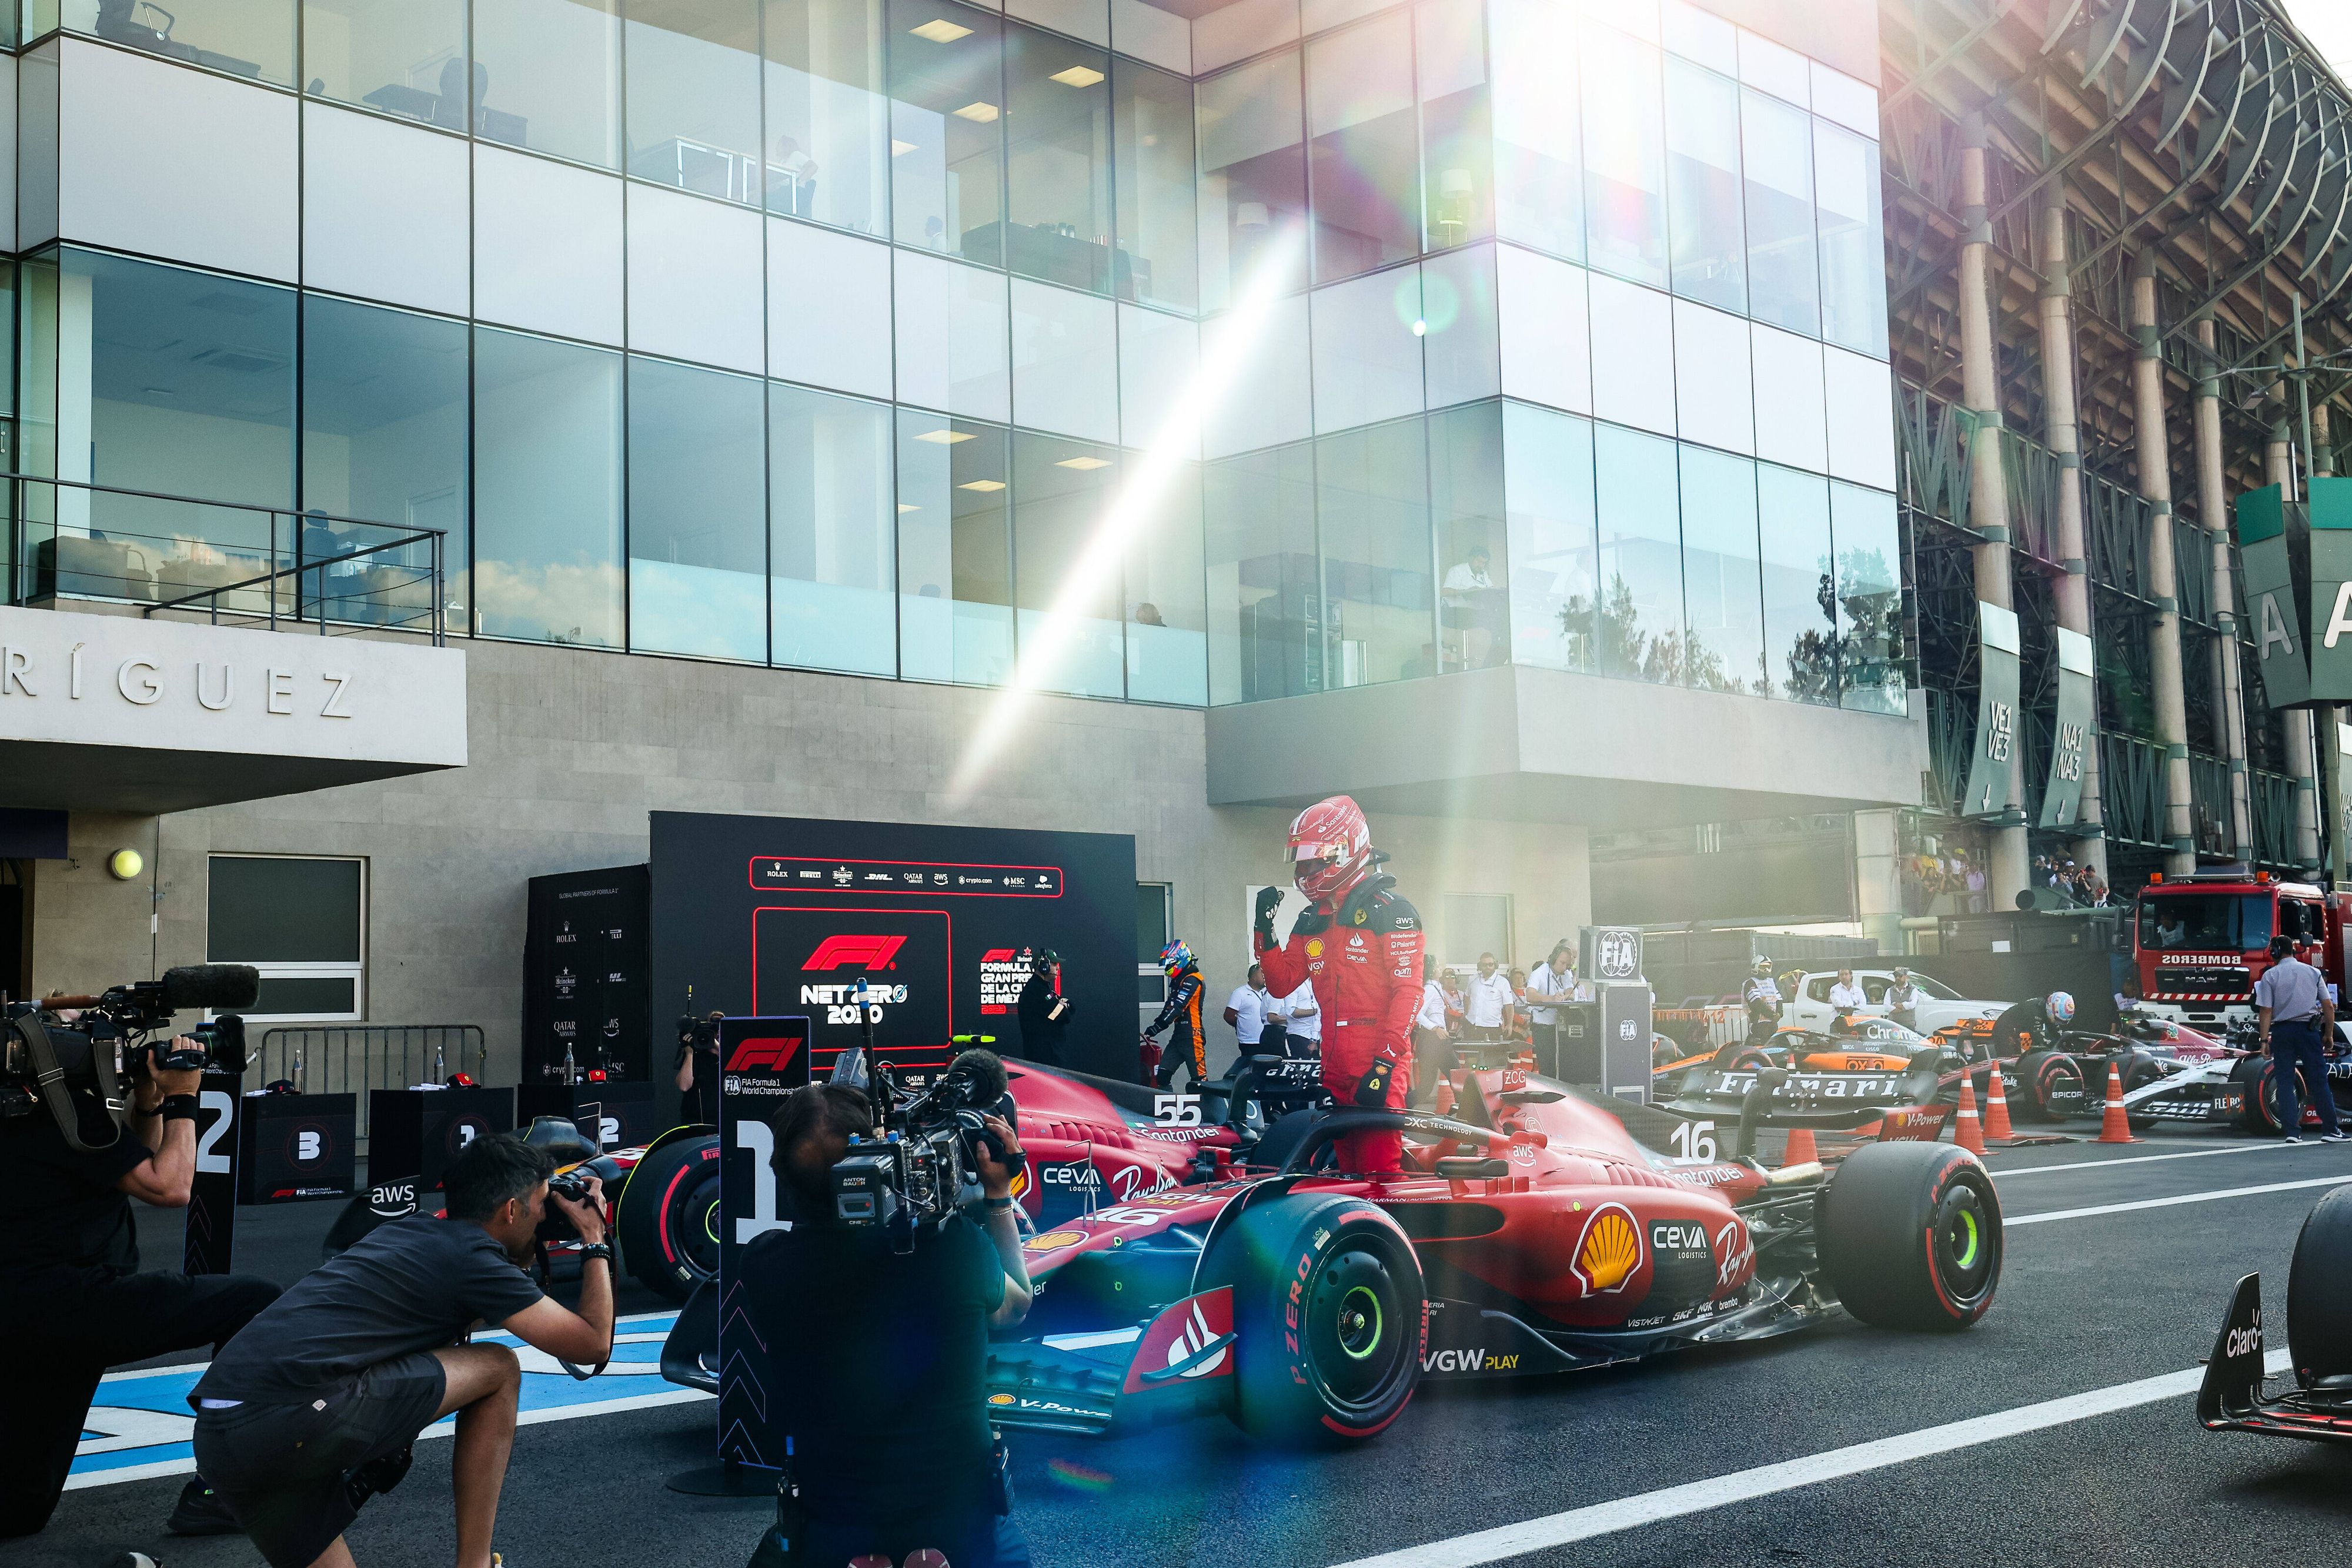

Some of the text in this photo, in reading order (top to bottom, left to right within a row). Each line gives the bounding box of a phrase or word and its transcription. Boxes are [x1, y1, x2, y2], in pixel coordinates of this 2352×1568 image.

[2323, 581, 2352, 648] A
[2261, 592, 2294, 660] A
[1990, 700, 2012, 734] VE1
[1987, 729, 2011, 762] VE3
[2061, 722, 2083, 752] NA1
[2056, 752, 2081, 782] NA3
[1326, 804, 1348, 828] Santander
[903, 872, 923, 881] QATAR
[1010, 877, 1025, 885] MSC
[1395, 917, 1414, 925] aws
[556, 934, 577, 943] ROLEX
[980, 962, 1031, 972] FORMULA
[980, 973, 1011, 983] GRAN
[800, 984, 850, 1005] NET
[980, 984, 995, 994] DE
[995, 984, 1010, 994] LA
[980, 994, 995, 1004] DE
[1412, 994, 1421, 1014] MILLE
[981, 1005, 1007, 1014] 2023
[554, 1021, 576, 1032] QATAR
[1867, 1024, 1919, 1042] Chrome
[2179, 1055, 2200, 1065] Alfa
[1505, 1070, 1526, 1085] ZCG
[2000, 1074, 2018, 1087] Stake
[1154, 1094, 1202, 1128] 55
[1907, 1113, 1945, 1127] V-Power
[196, 1091, 233, 1174] 2
[600, 1117, 619, 1144] 2
[1141, 1126, 1220, 1143] Santander
[1429, 1121, 1472, 1136] TECHNOLOGY
[298, 1131, 320, 1160] 3
[1513, 1145, 1534, 1158] aws
[1671, 1121, 1716, 1165] 16
[736, 1120, 793, 1244] 1
[1662, 1166, 1745, 1187] Santander
[372, 1184, 415, 1204] aws
[1074, 1206, 1178, 1226] 16
[1697, 1300, 1714, 1314] NGK
[1719, 1297, 1738, 1310] brembo
[1285, 1253, 1312, 1385] P ZERO
[1628, 1316, 1666, 1328] VISTAJET
[1672, 1308, 1695, 1321] SKF
[2227, 1325, 2258, 1359] Claro
[1422, 1348, 1519, 1372] VGW PLAY
[1021, 1399, 1112, 1417] V-Powe
